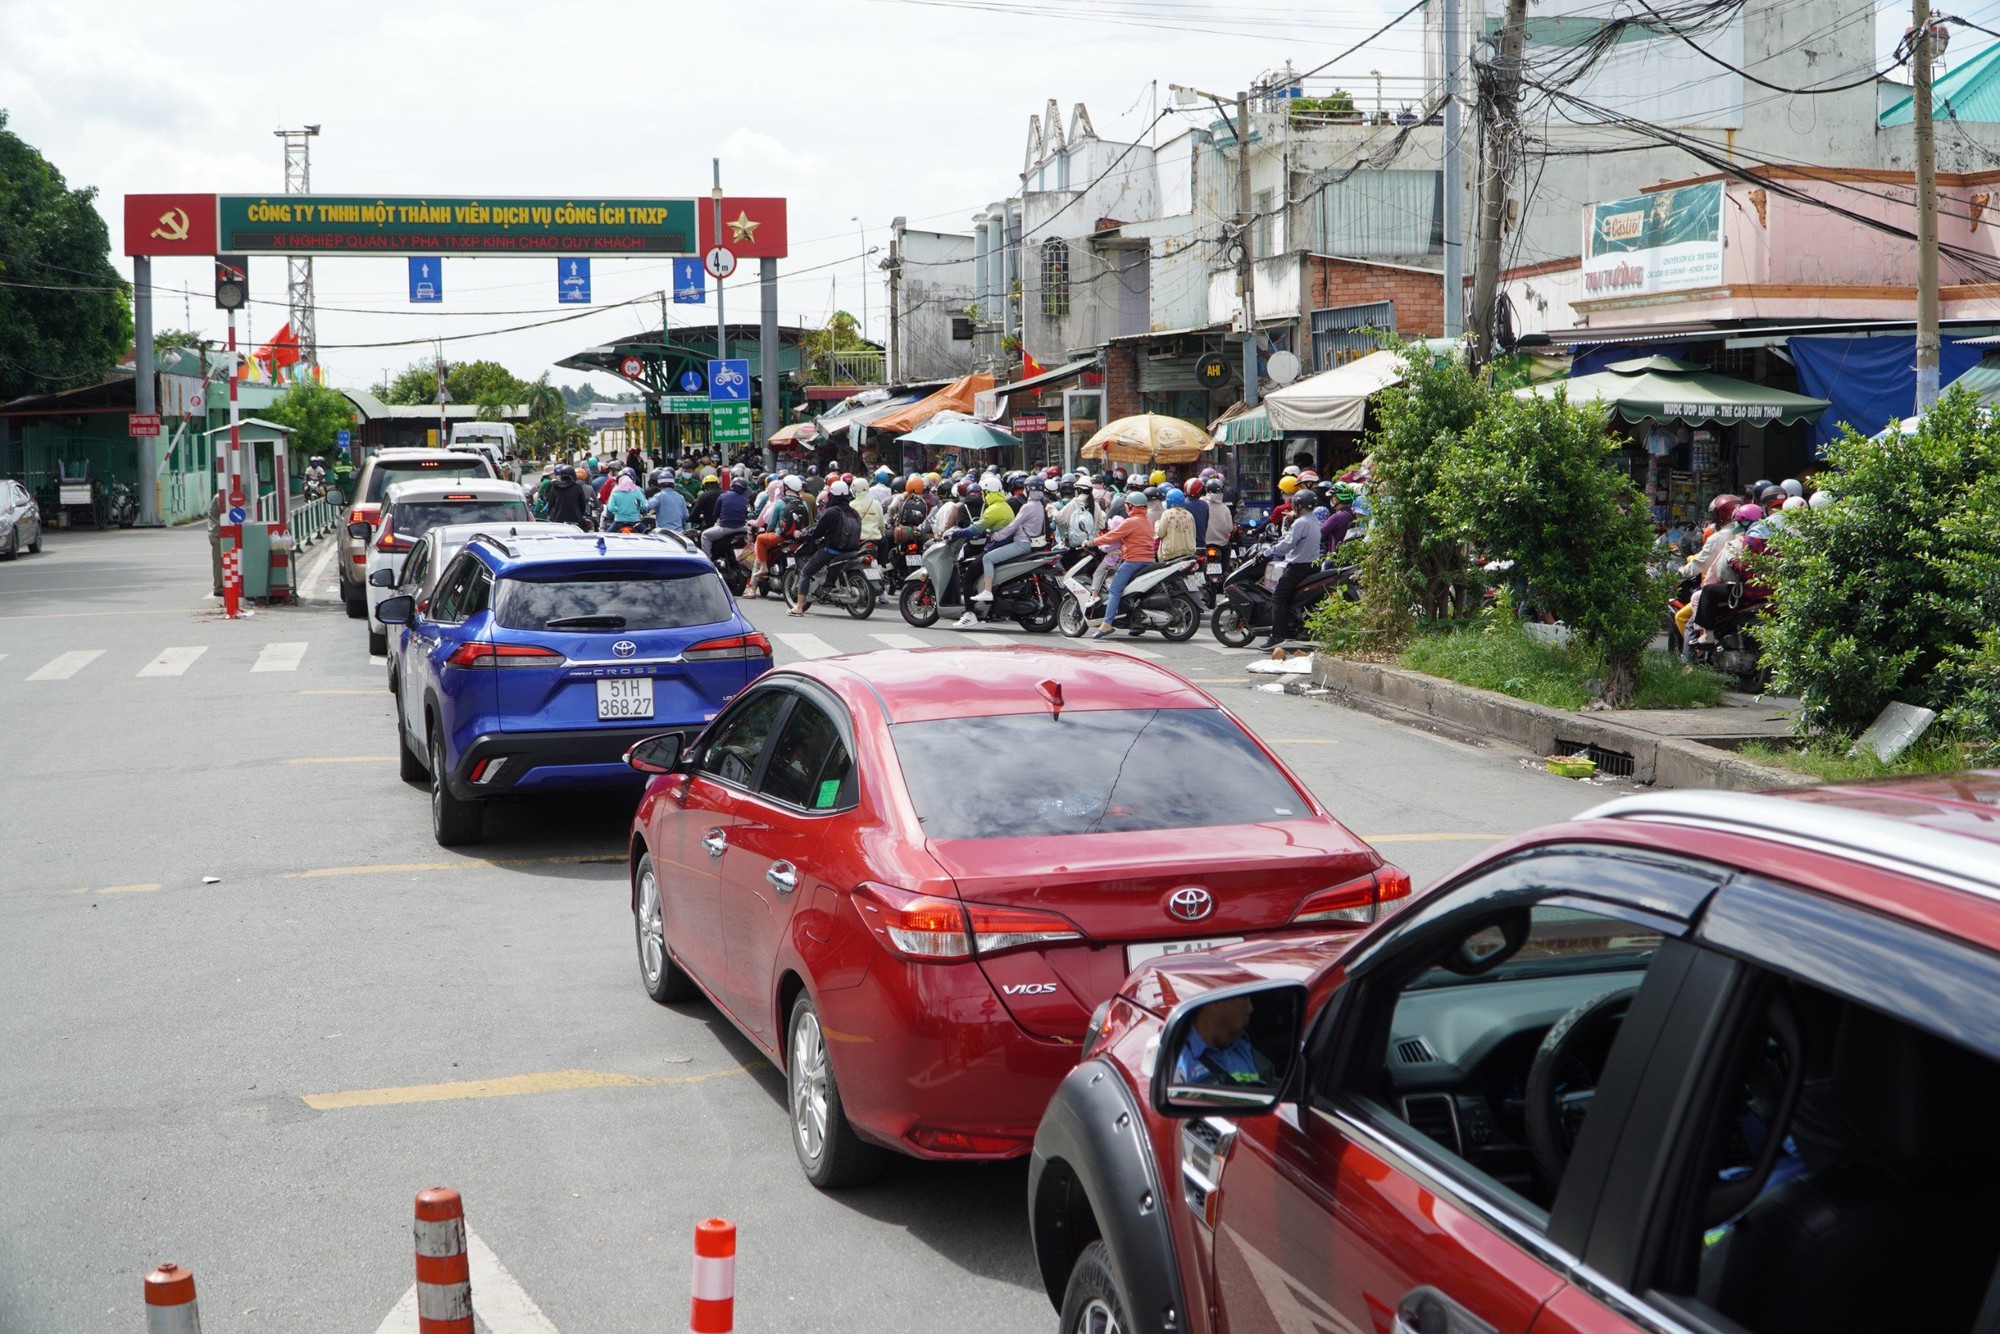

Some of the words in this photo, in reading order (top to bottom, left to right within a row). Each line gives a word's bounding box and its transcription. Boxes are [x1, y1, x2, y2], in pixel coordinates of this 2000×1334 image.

[248, 199, 291, 222] CÔNG
[294, 205, 314, 222] TY
[318, 205, 358, 223] TNHH
[361, 200, 396, 227] MỘT
[398, 200, 451, 224] THÀNH
[455, 201, 490, 224] VIÊN
[493, 206, 529, 229] DỊCH
[532, 206, 551, 229] VỤ
[554, 202, 597, 224] CÔNG
[598, 202, 626, 224] ÍCH
[627, 207, 668, 225] TNXP
[1611, 214, 1641, 237] Castrol
[443, 235, 480, 248] TNXP
[713, 252, 720, 272] 4
[1206, 364, 1221, 377] AHI
[1698, 404, 1716, 419] LẠNH
[593, 667, 657, 676] CROSS
[610, 680, 640, 697] 51H
[600, 697, 652, 716] 368.27
[1002, 982, 1057, 995] VIOS
